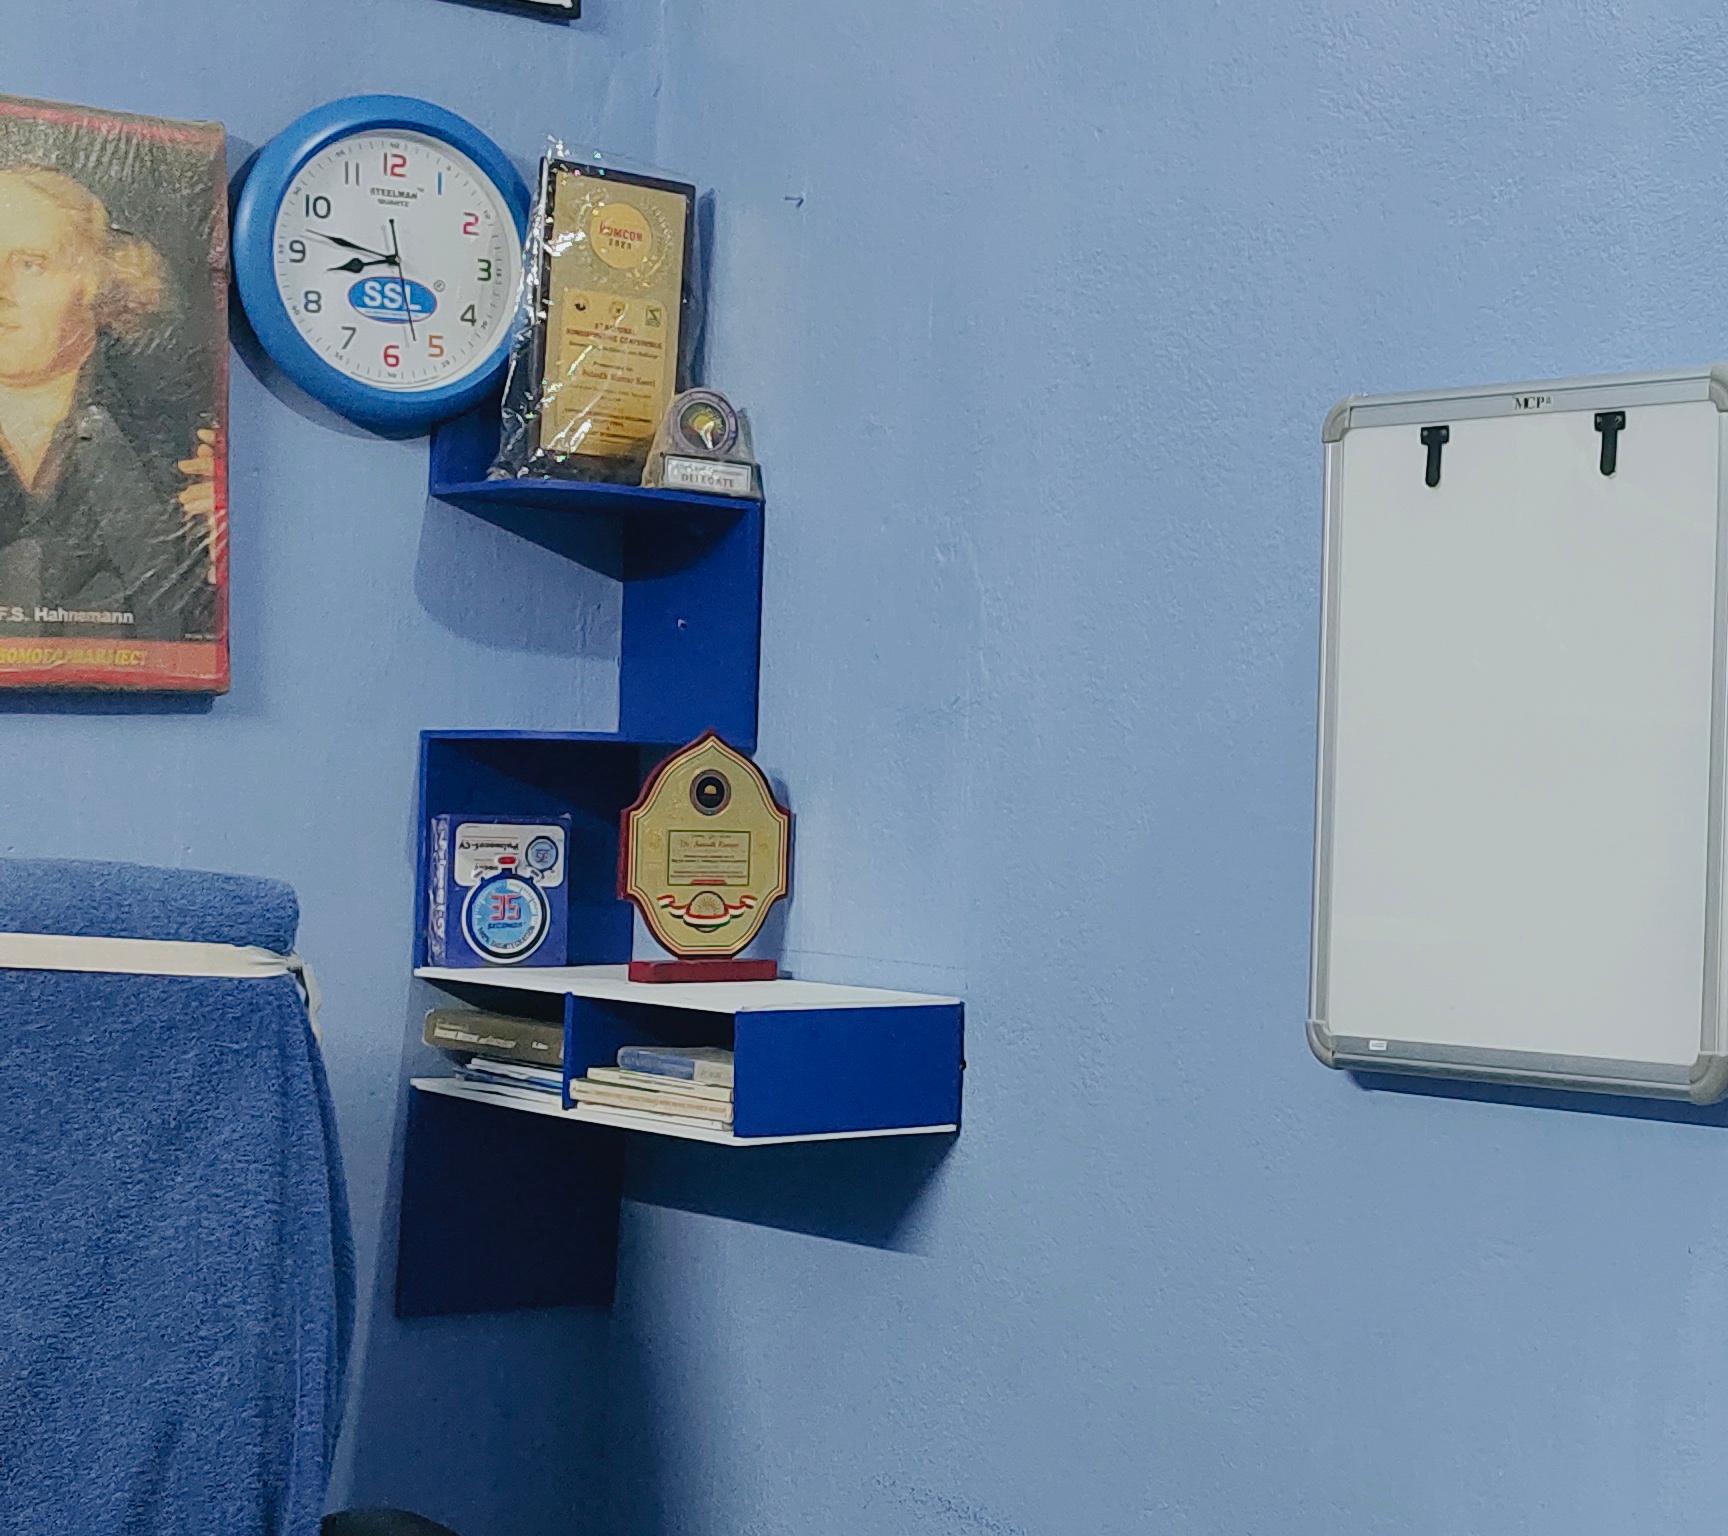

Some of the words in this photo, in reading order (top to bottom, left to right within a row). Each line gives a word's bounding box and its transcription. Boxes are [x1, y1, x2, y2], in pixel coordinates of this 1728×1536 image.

[345, 161, 359, 186] 11
[384, 152, 407, 178] 12
[306, 194, 331, 219] 10
[464, 212, 479, 236] 2
[289, 240, 306, 263] 9
[477, 258, 492, 282] 3
[304, 290, 322, 313] 8
[363, 281, 422, 310] SSL
[460, 304, 476, 326] 4
[341, 326, 356, 350] 7
[428, 335, 444, 358] 5
[383, 345, 400, 367] 6
[34, 606, 134, 624] Hahnemann
